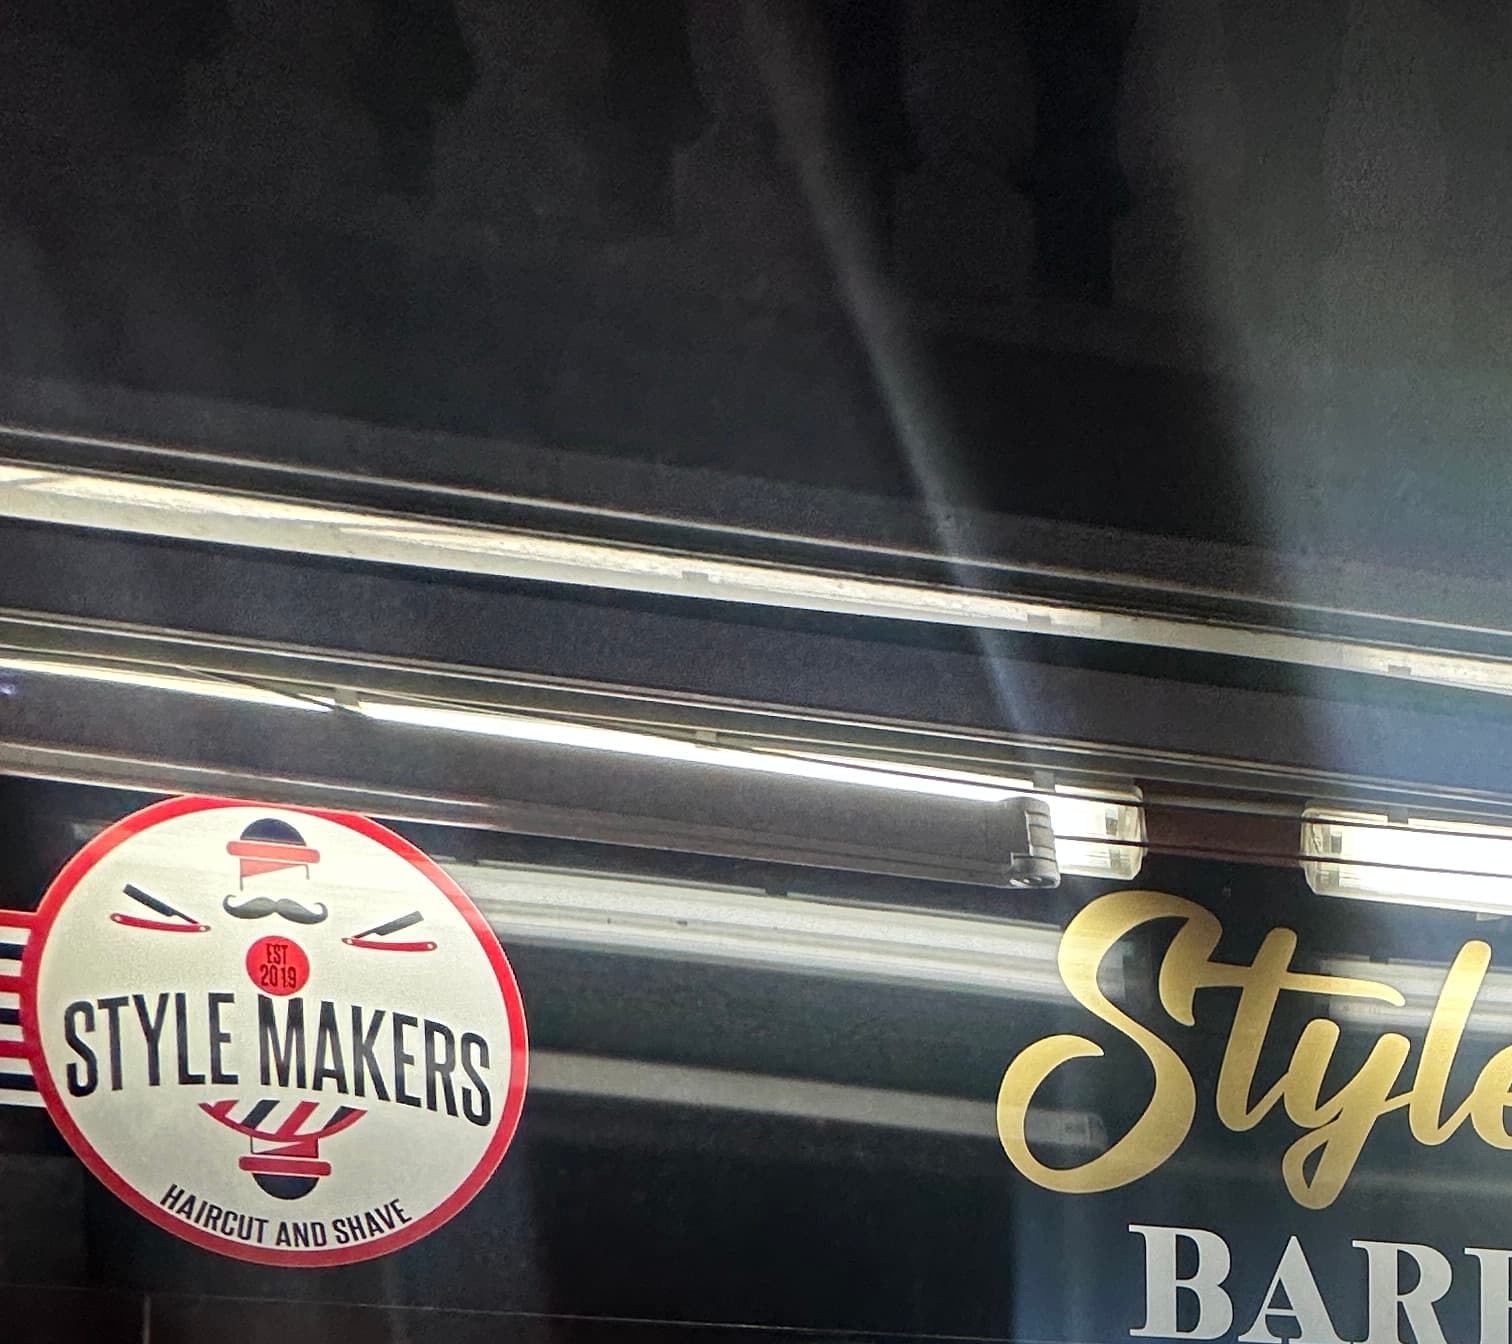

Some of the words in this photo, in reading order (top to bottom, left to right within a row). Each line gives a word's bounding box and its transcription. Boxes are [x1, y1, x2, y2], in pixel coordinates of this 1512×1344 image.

[259, 963, 298, 988] 2019
[266, 943, 289, 965] EST
[63, 991, 239, 1098] STYLE
[258, 995, 492, 1127] MAKERS
[160, 1183, 271, 1243] HAIRCUT
[275, 1219, 328, 1248] AND
[333, 1198, 413, 1243] SHAVE
